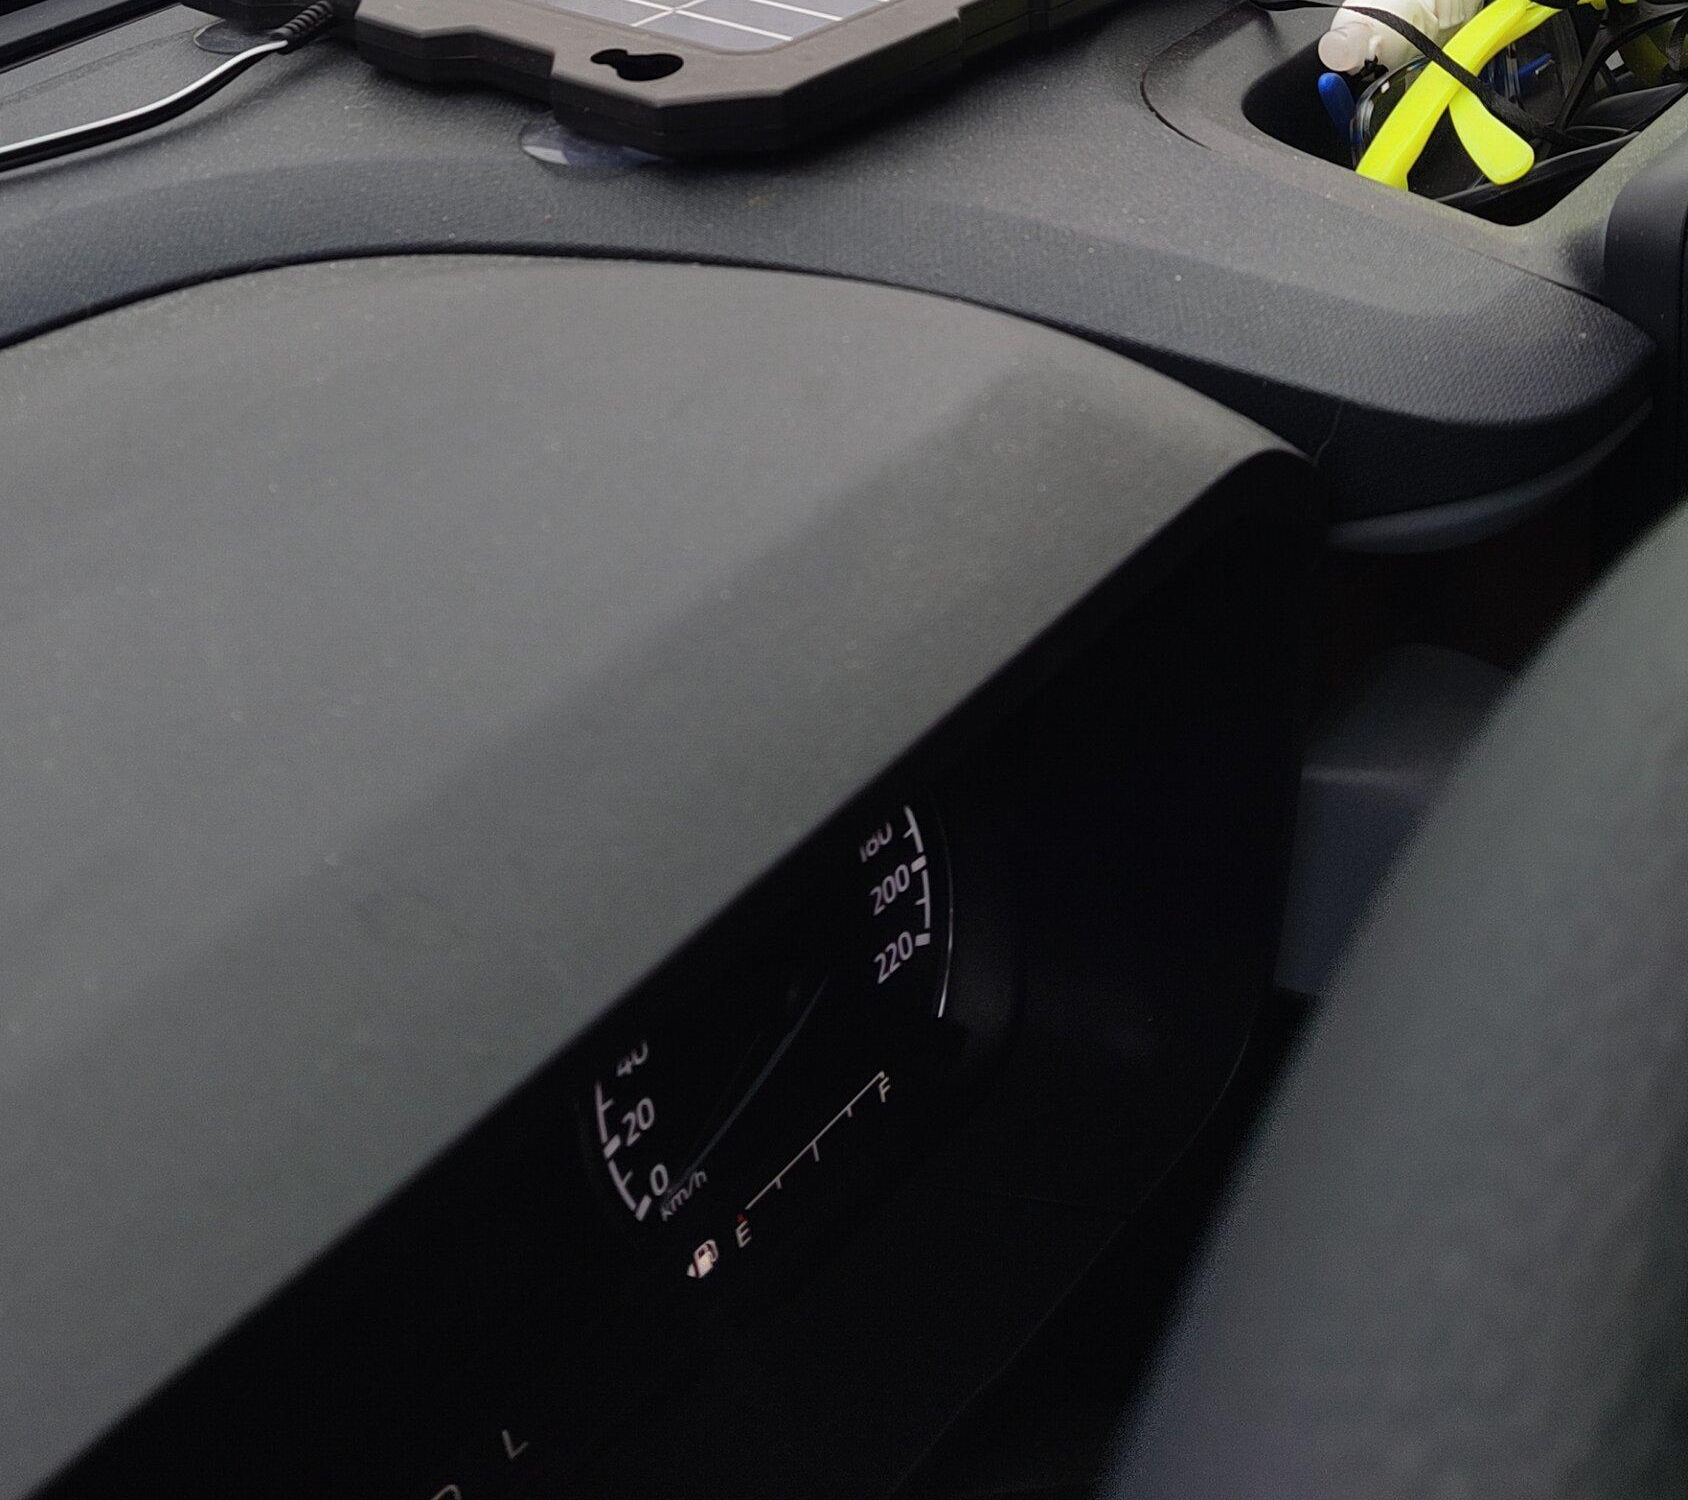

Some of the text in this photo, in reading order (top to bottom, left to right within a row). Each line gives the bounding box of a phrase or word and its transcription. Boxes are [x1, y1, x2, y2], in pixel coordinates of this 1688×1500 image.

[869, 863, 910, 916] 200
[873, 931, 913, 984] 220
[877, 1075, 890, 1103] F
[622, 1097, 655, 1146] 20
[650, 1164, 669, 1196] 0
[735, 1220, 751, 1248] E
